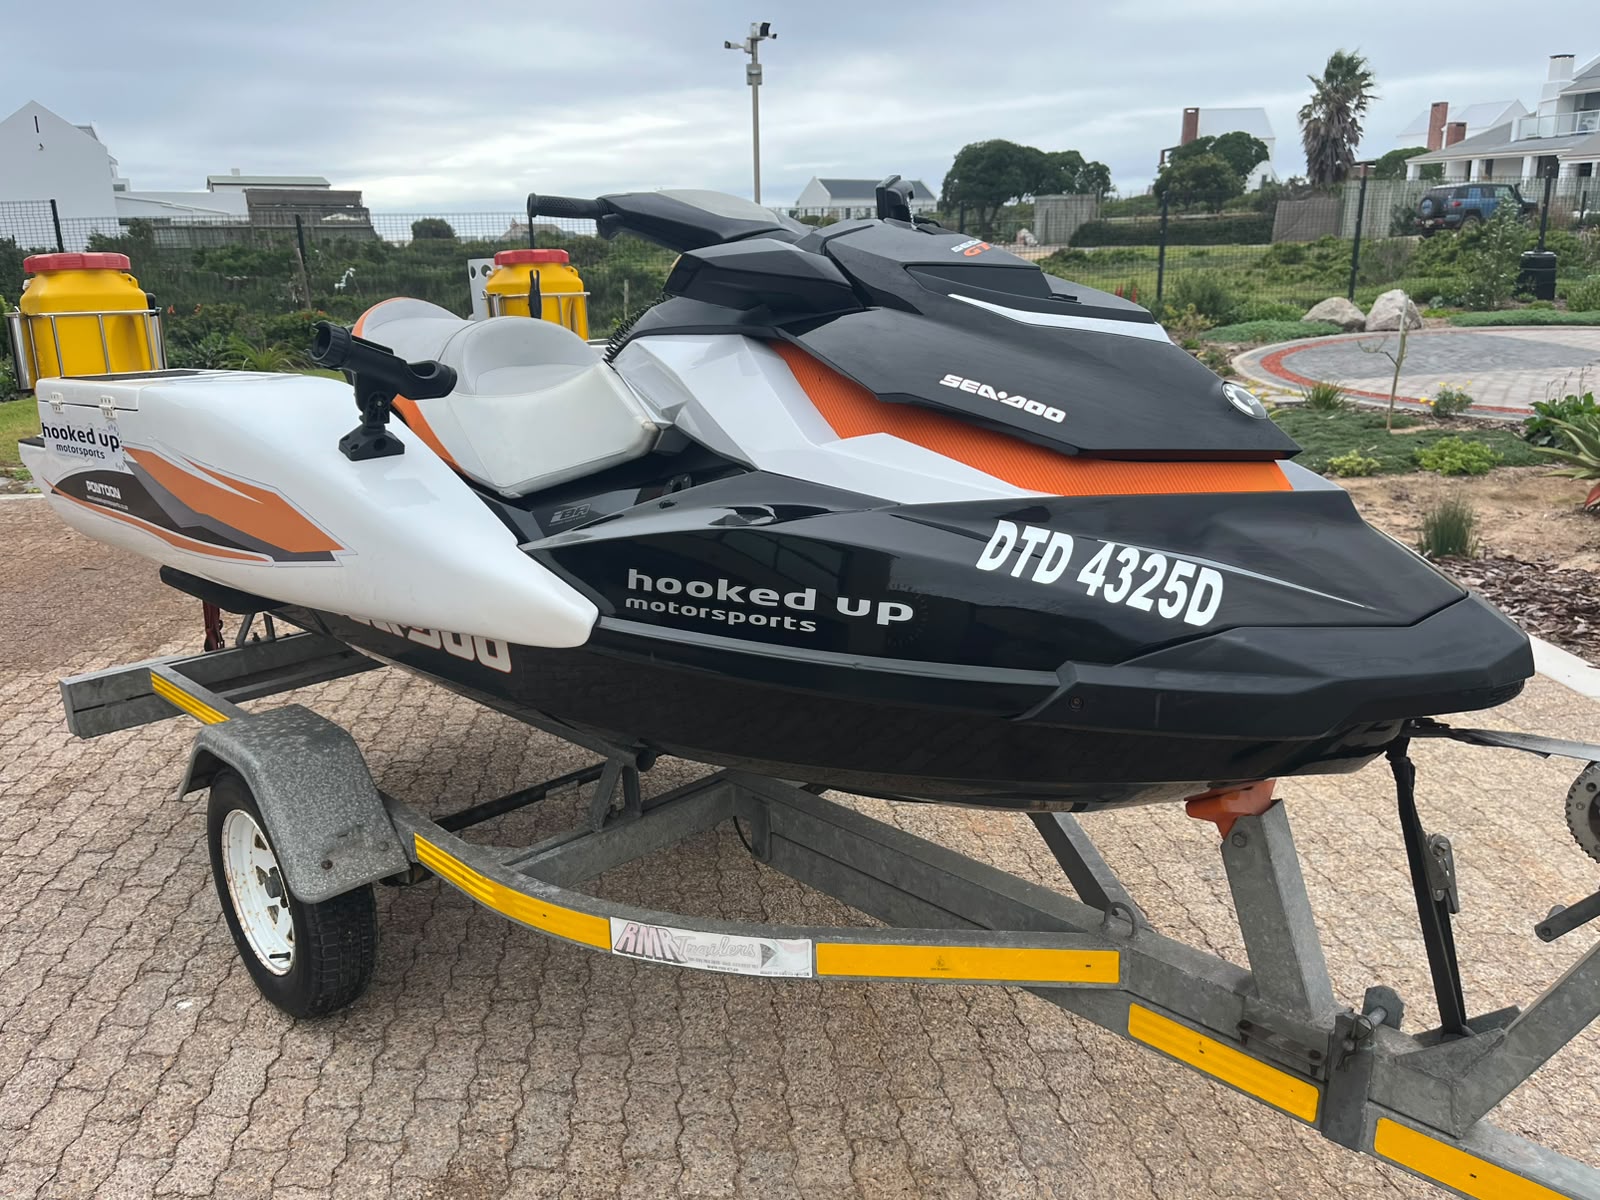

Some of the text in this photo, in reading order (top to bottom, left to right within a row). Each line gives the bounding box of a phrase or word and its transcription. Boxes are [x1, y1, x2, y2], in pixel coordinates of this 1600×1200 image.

[42, 422, 119, 453] hooked up
[56, 443, 105, 459] motorsports
[86, 480, 121, 500] PONTOON
[976, 520, 1224, 627] DTD 4325D
[627, 568, 914, 626] hooked up
[625, 596, 817, 633] motorsports
